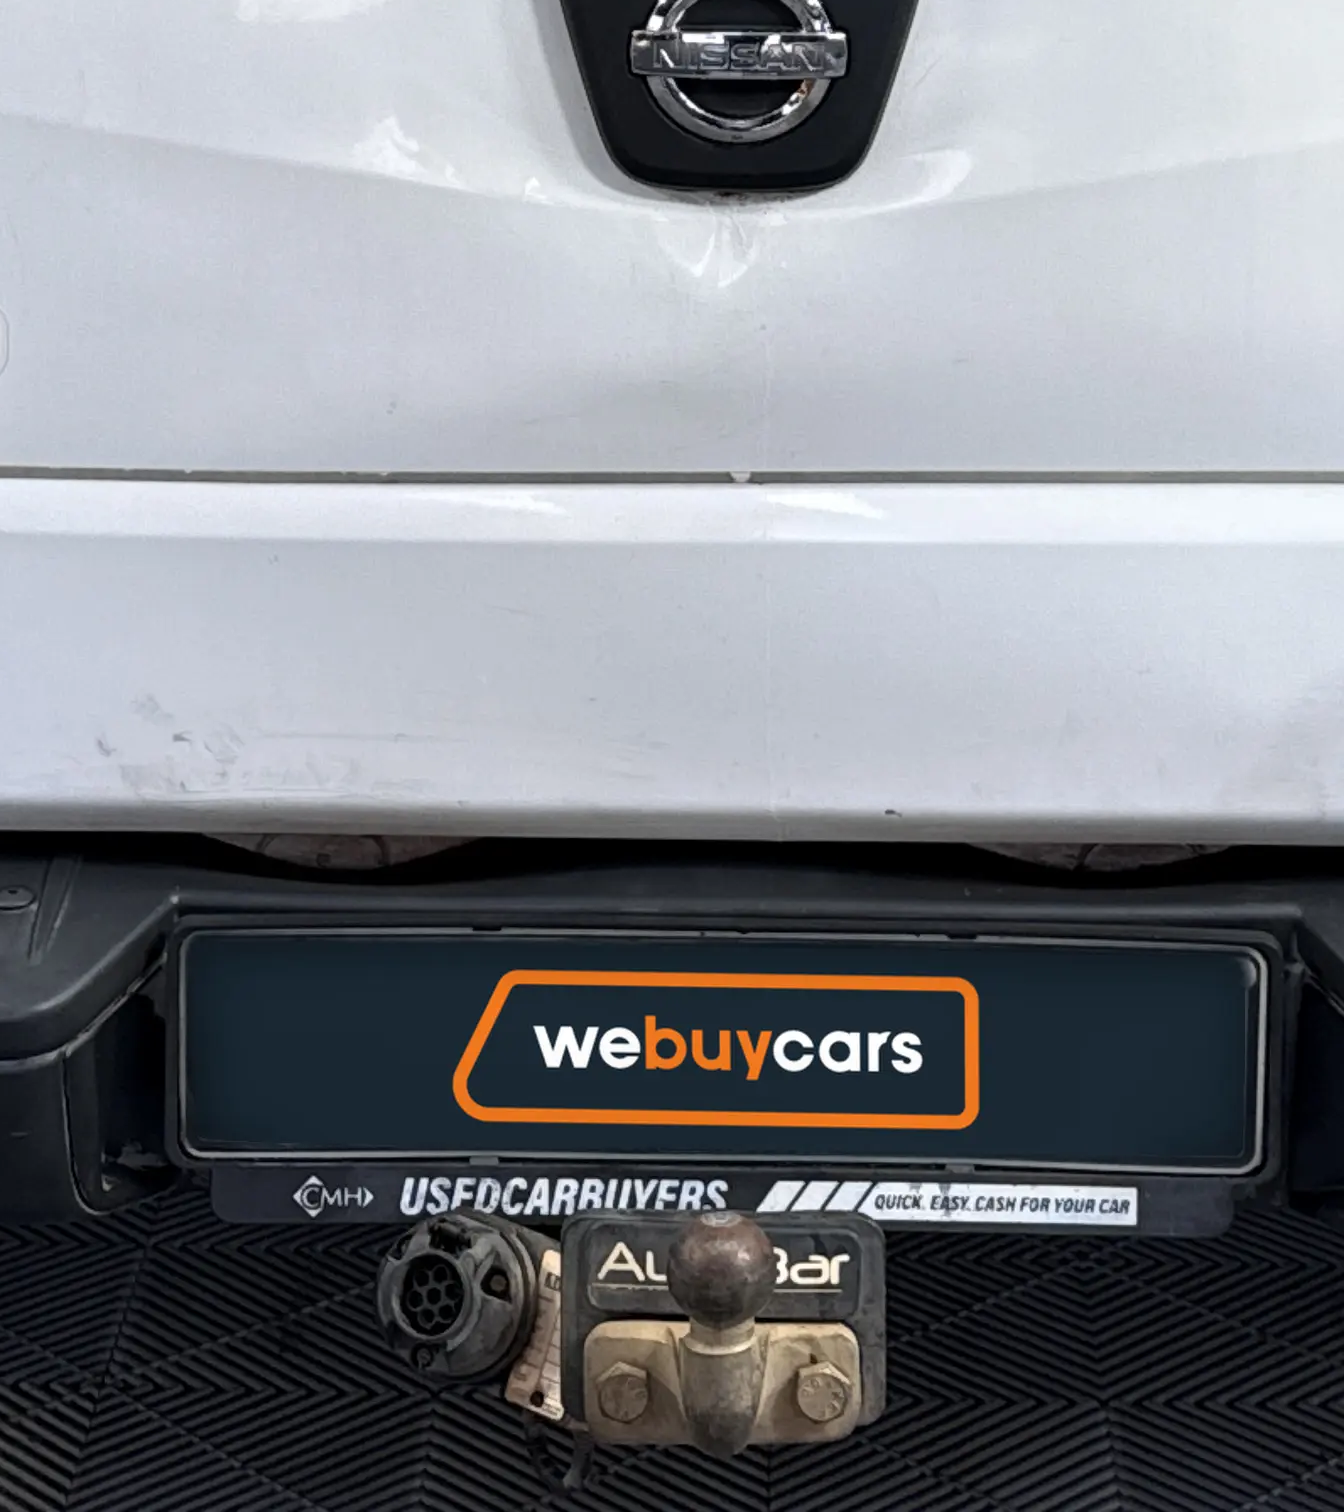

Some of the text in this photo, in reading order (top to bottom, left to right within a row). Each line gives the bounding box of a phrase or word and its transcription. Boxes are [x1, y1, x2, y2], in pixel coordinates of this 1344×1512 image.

[653, 41, 825, 72] NISSAN
[301, 1186, 362, 1208] CMH
[975, 1195, 1017, 1213] CASH
[1019, 1196, 1051, 1213] FOR
[1054, 1197, 1096, 1214] YOUR
[1098, 1199, 1131, 1215] CAR
